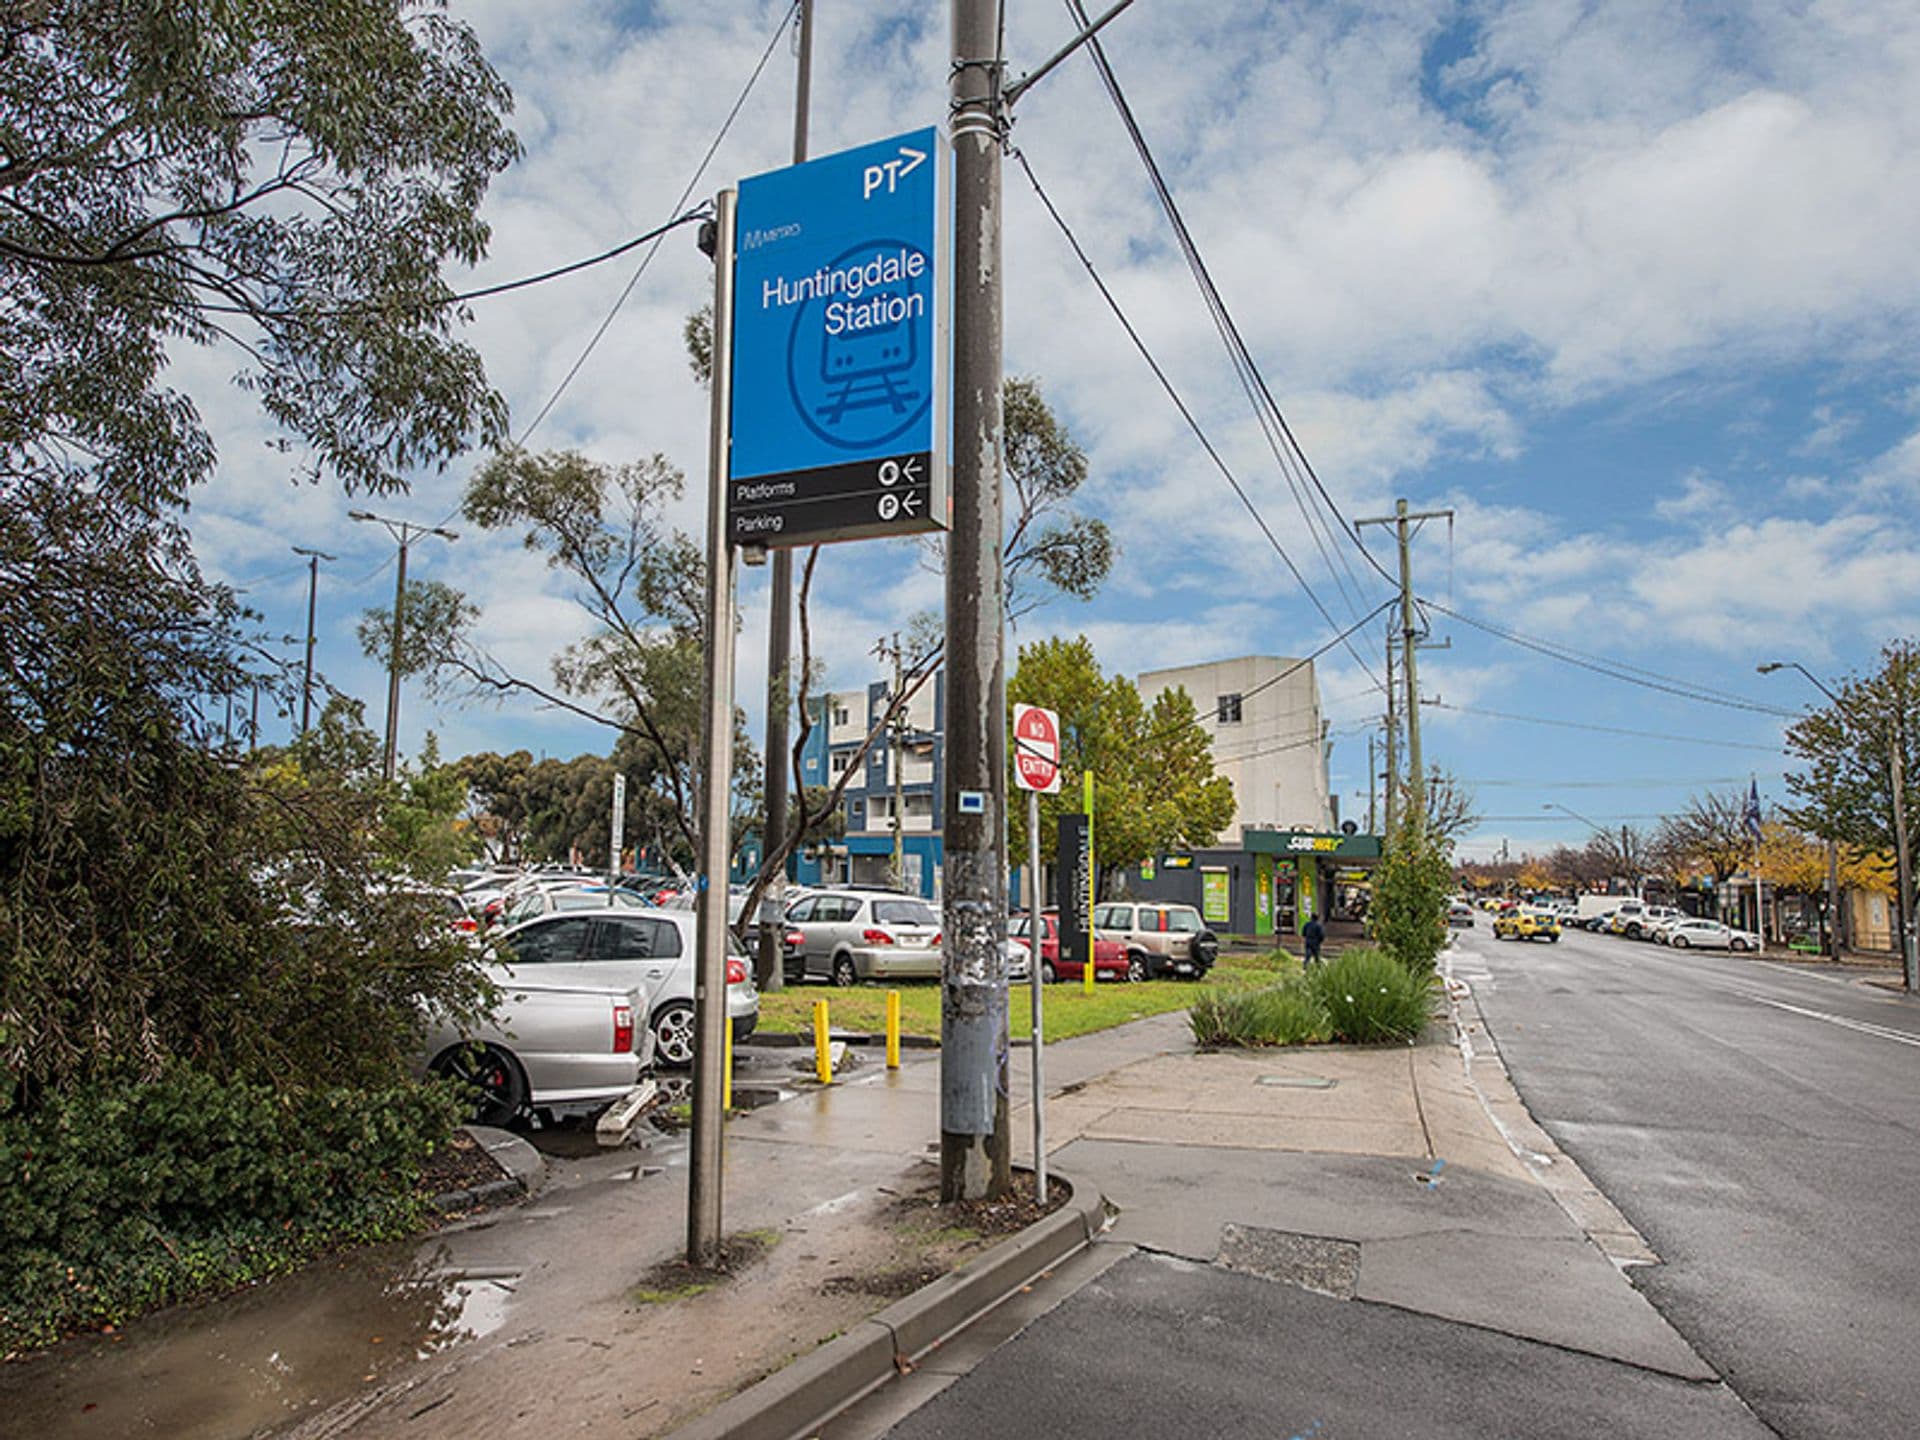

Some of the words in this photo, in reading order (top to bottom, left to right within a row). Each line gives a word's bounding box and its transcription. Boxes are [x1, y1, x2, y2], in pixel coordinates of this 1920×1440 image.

[762, 248, 926, 309] Huntingdale
[825, 292, 924, 335] Station
[736, 482, 796, 500] Platforms
[736, 514, 784, 532] Parking
